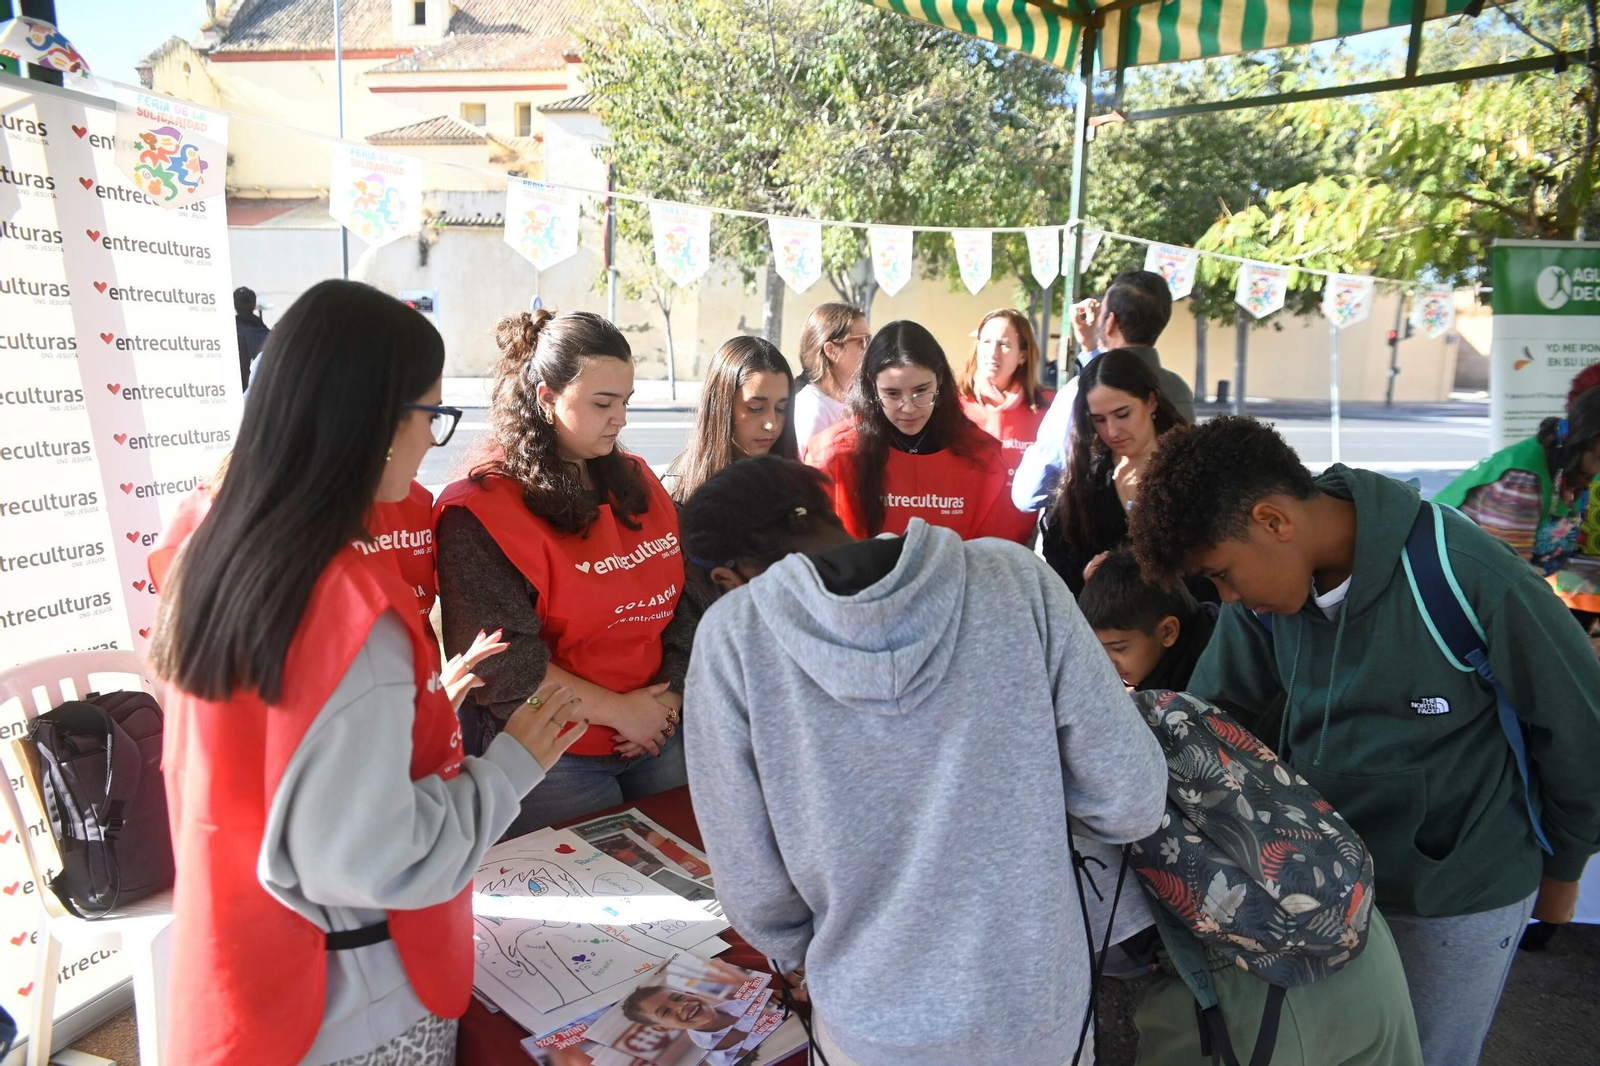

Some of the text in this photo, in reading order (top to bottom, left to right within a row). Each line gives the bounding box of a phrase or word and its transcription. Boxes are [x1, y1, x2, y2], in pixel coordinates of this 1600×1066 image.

[137, 94, 207, 121] FERIA DE LA
[136, 107, 207, 132] SOLIDARIDAD
[0, 220, 63, 244] lturas
[102, 235, 212, 260] entreculturas
[109, 285, 217, 305] entreculturas
[115, 335, 221, 351] entreculturas
[1563, 343, 1577, 353] ME
[1548, 357, 1561, 367] EN
[1564, 357, 1577, 367] SU
[122, 383, 226, 401] entreculturas
[128, 428, 231, 450] entreculturas
[535, 1023, 588, 1048] ANUAL 2024
